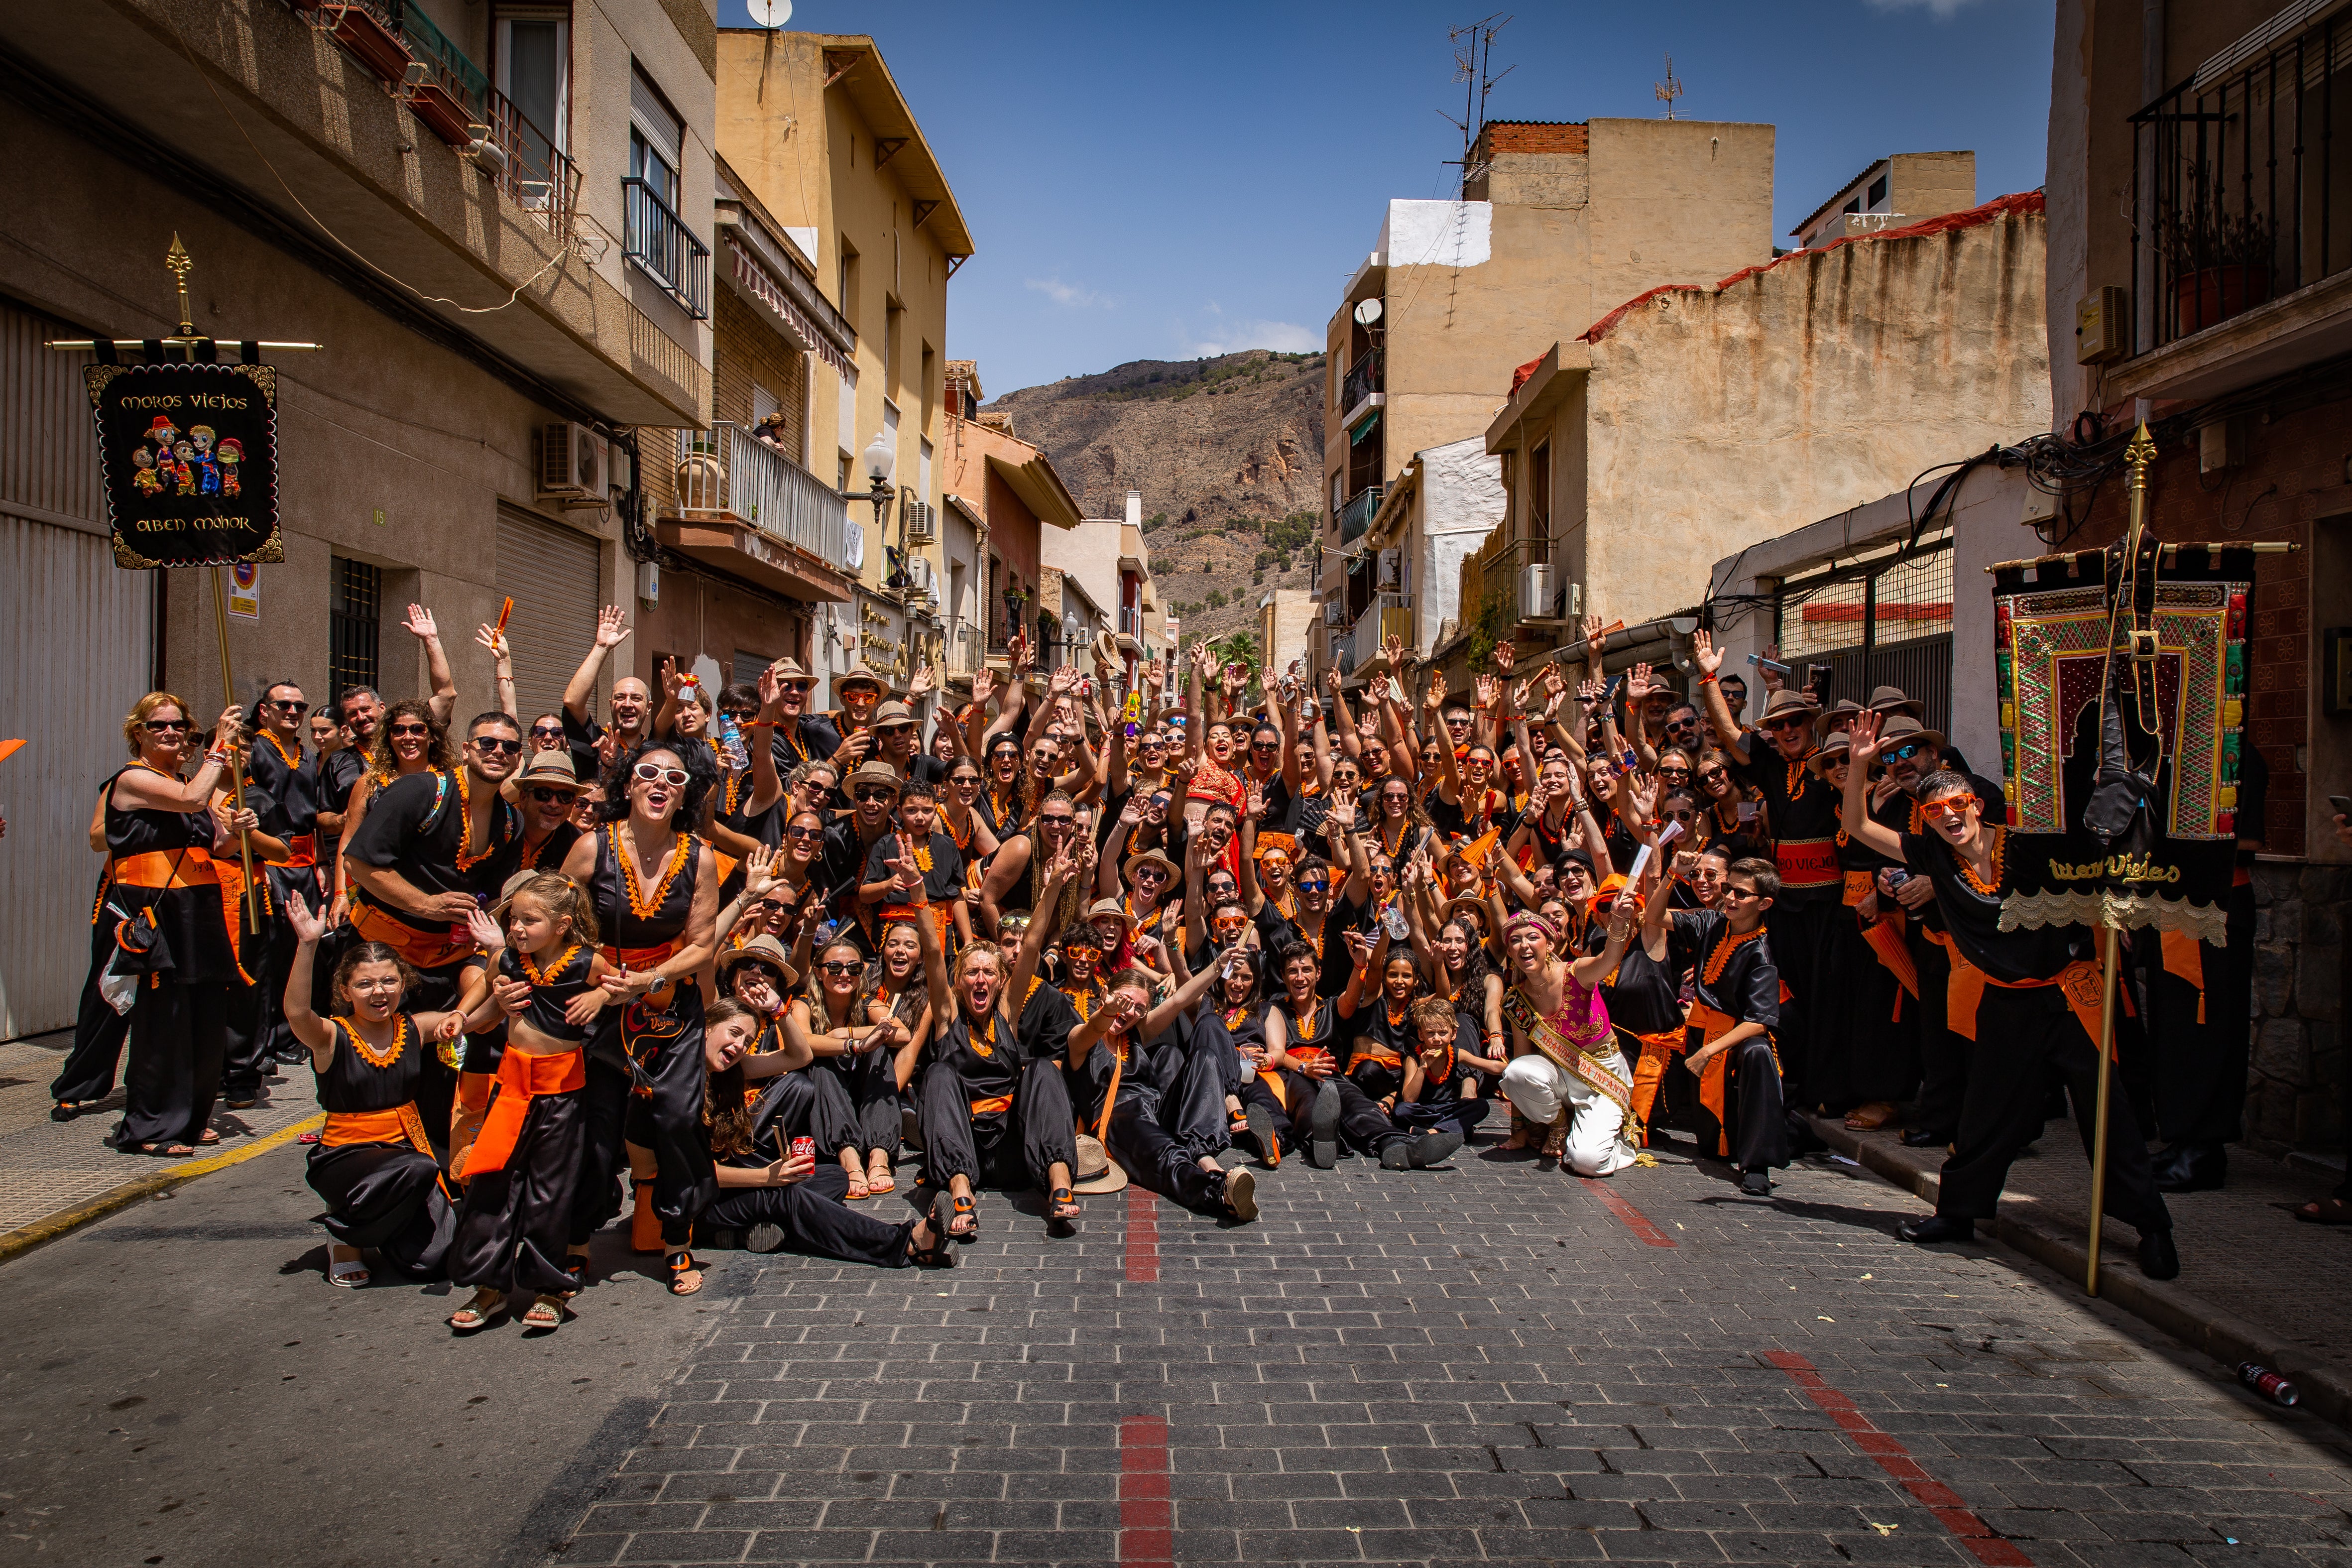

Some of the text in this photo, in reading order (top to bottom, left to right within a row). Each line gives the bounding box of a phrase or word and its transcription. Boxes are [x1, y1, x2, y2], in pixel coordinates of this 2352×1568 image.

[376, 510, 384, 524] 15
[1777, 855, 1834, 870] ORO VIEJO
[1540, 1034, 1628, 1103] ABANDERADA INFANTIL
[792, 1140, 815, 1155] Coca-Co
